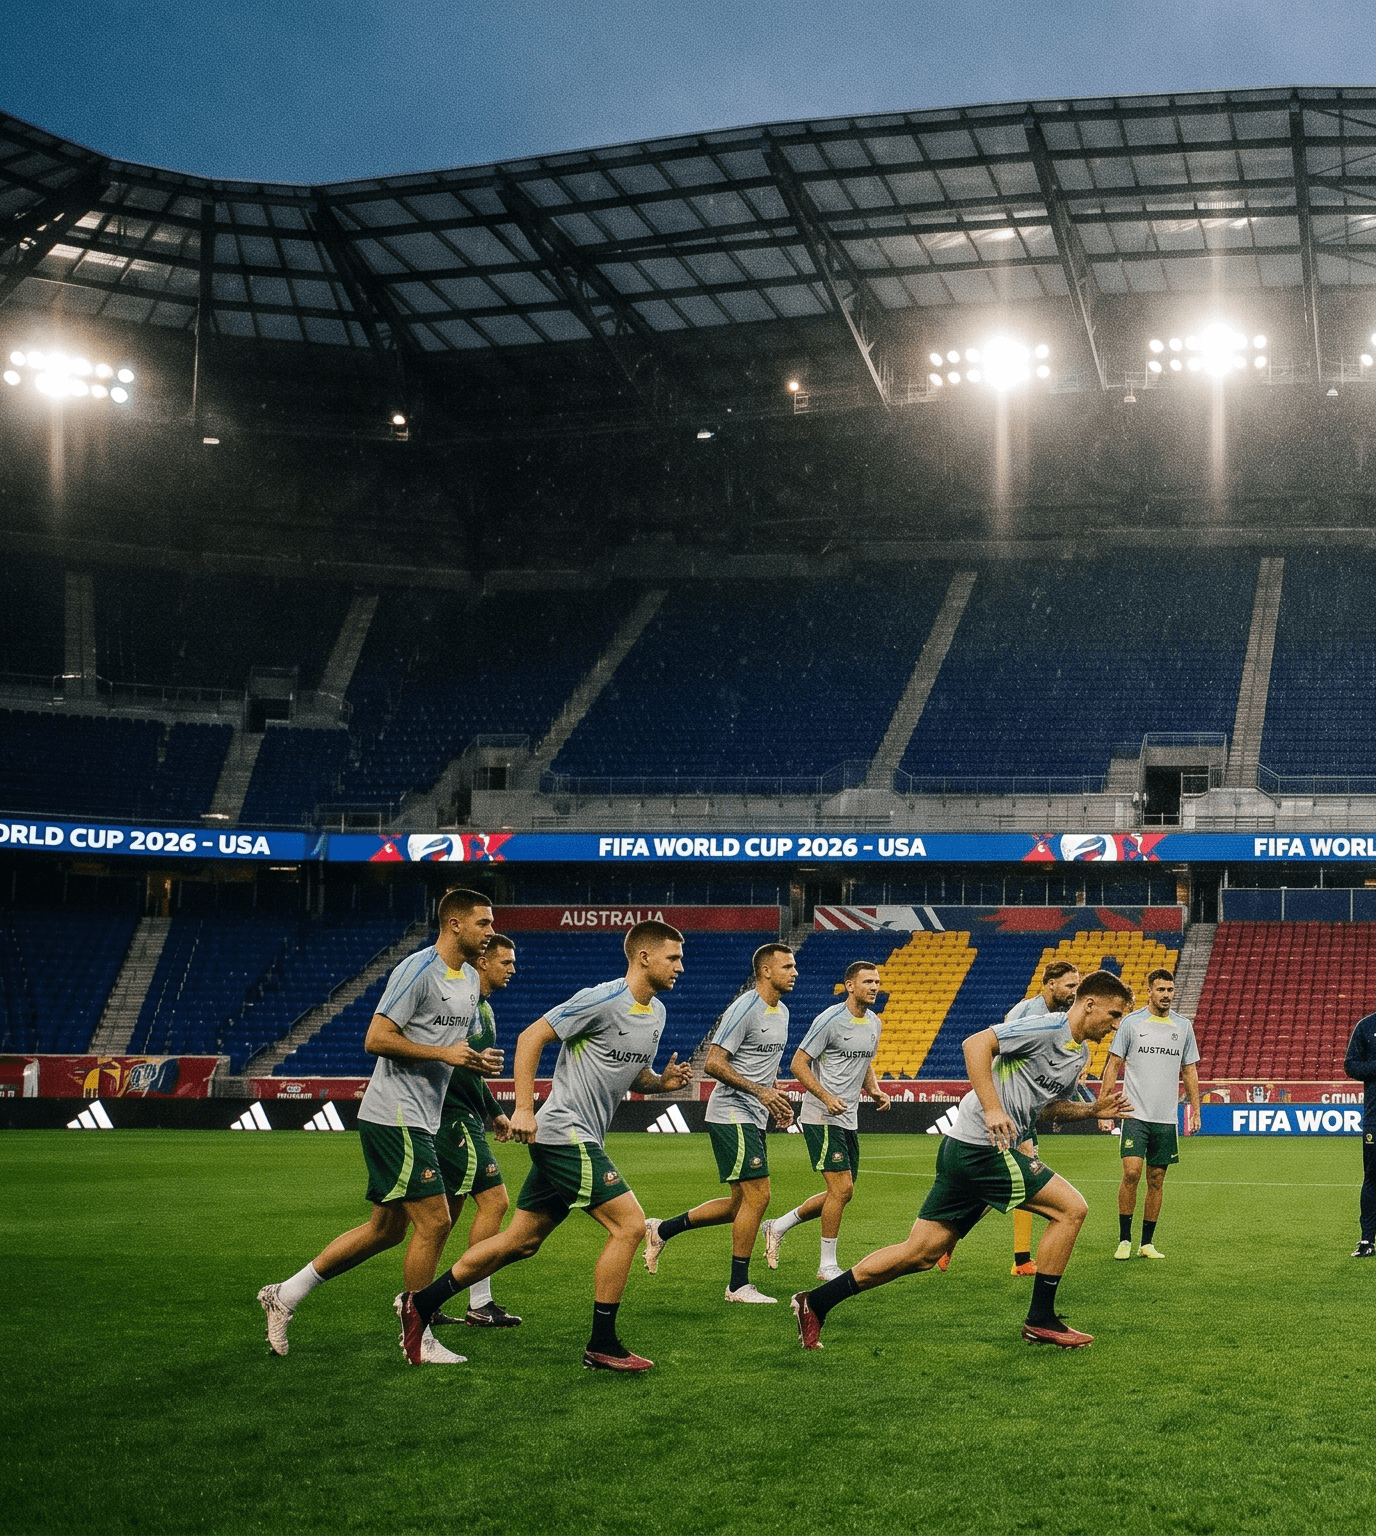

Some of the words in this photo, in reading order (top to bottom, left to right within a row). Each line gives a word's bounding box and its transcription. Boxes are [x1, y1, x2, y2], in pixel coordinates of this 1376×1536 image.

[70, 828, 124, 849] CUP
[130, 831, 197, 852] 2026
[218, 834, 271, 855] USA
[600, 838, 650, 857] FIFA
[654, 838, 740, 857] WORLD
[745, 838, 793, 857] CUP
[798, 838, 858, 857] 2026
[879, 838, 927, 857] USA
[1255, 838, 1306, 857] FIFA
[1137, 1046, 1180, 1056] AUSTRALIA
[1232, 1110, 1292, 1132] FIFA
[1296, 1110, 1363, 1132] WOR
